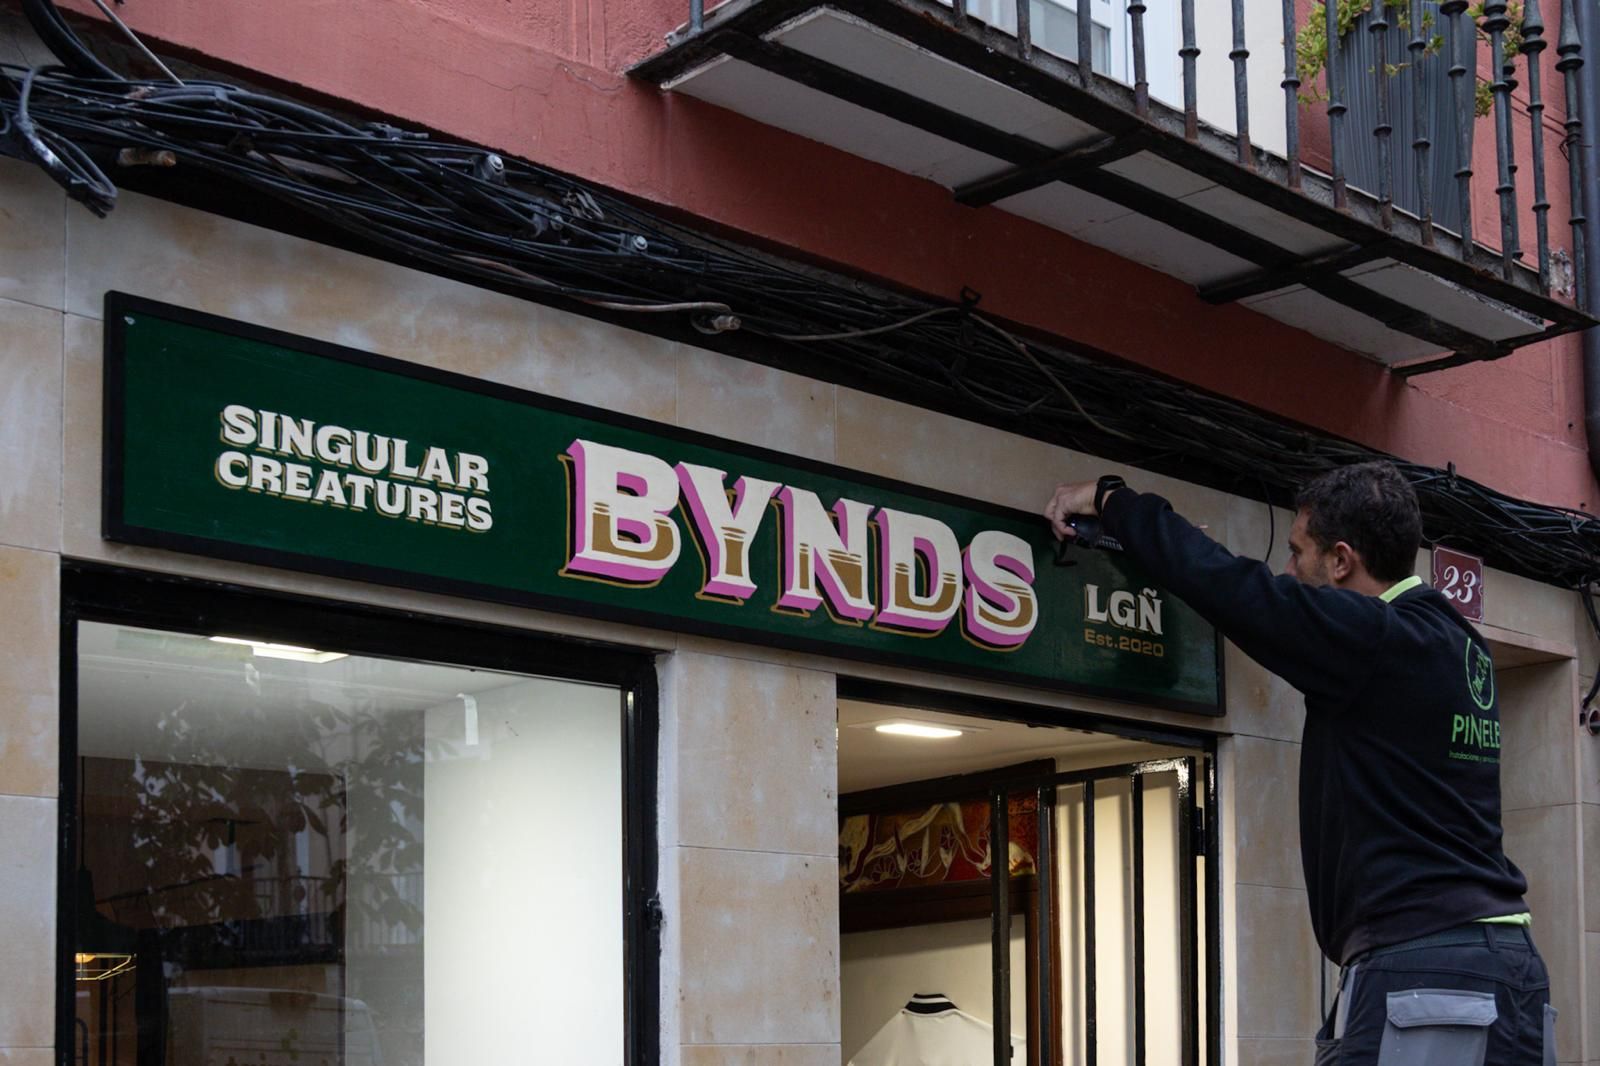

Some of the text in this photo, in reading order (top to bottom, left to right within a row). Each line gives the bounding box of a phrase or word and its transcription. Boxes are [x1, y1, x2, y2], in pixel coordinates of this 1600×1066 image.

[220, 404, 491, 494] SINGULAR
[215, 450, 493, 532] CREATURES
[558, 438, 1039, 652] BYNDS
[1441, 565, 1477, 604] 23
[1084, 583, 1164, 635] LGÑ
